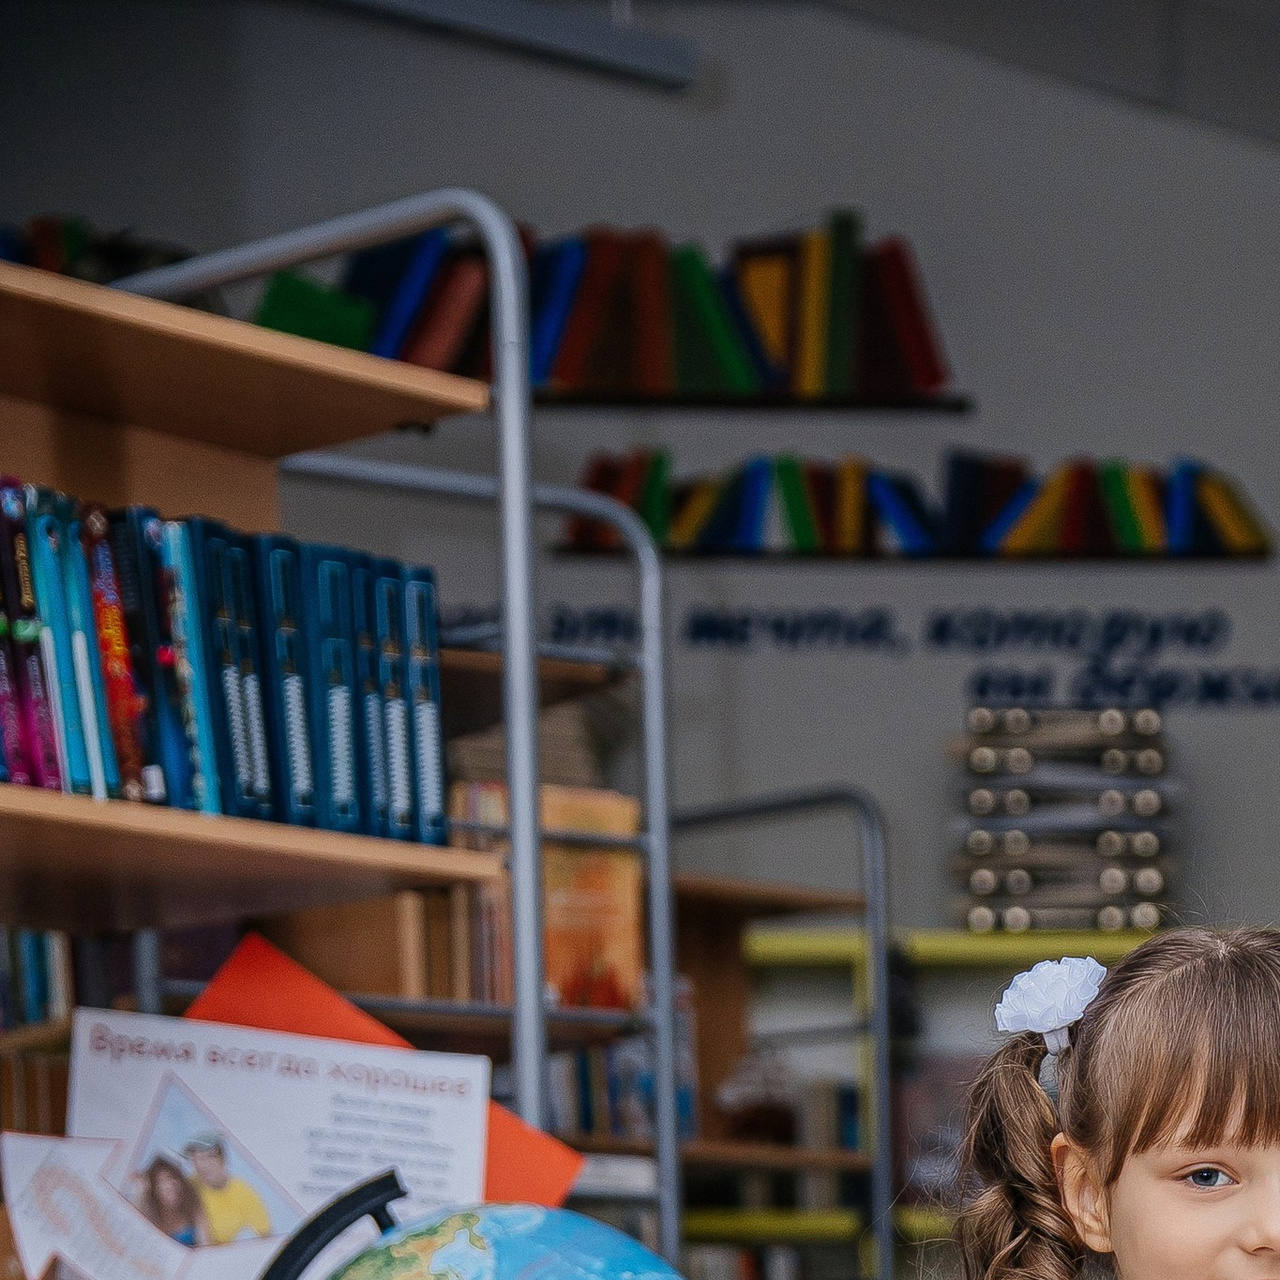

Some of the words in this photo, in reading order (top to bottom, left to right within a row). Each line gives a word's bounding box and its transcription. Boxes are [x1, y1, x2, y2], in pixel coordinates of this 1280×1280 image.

[930, 605, 1230, 662] которую
[89, 1021, 195, 1064] Время
[205, 1044, 319, 1078] всегда
[326, 1058, 471, 1097] хорошее
